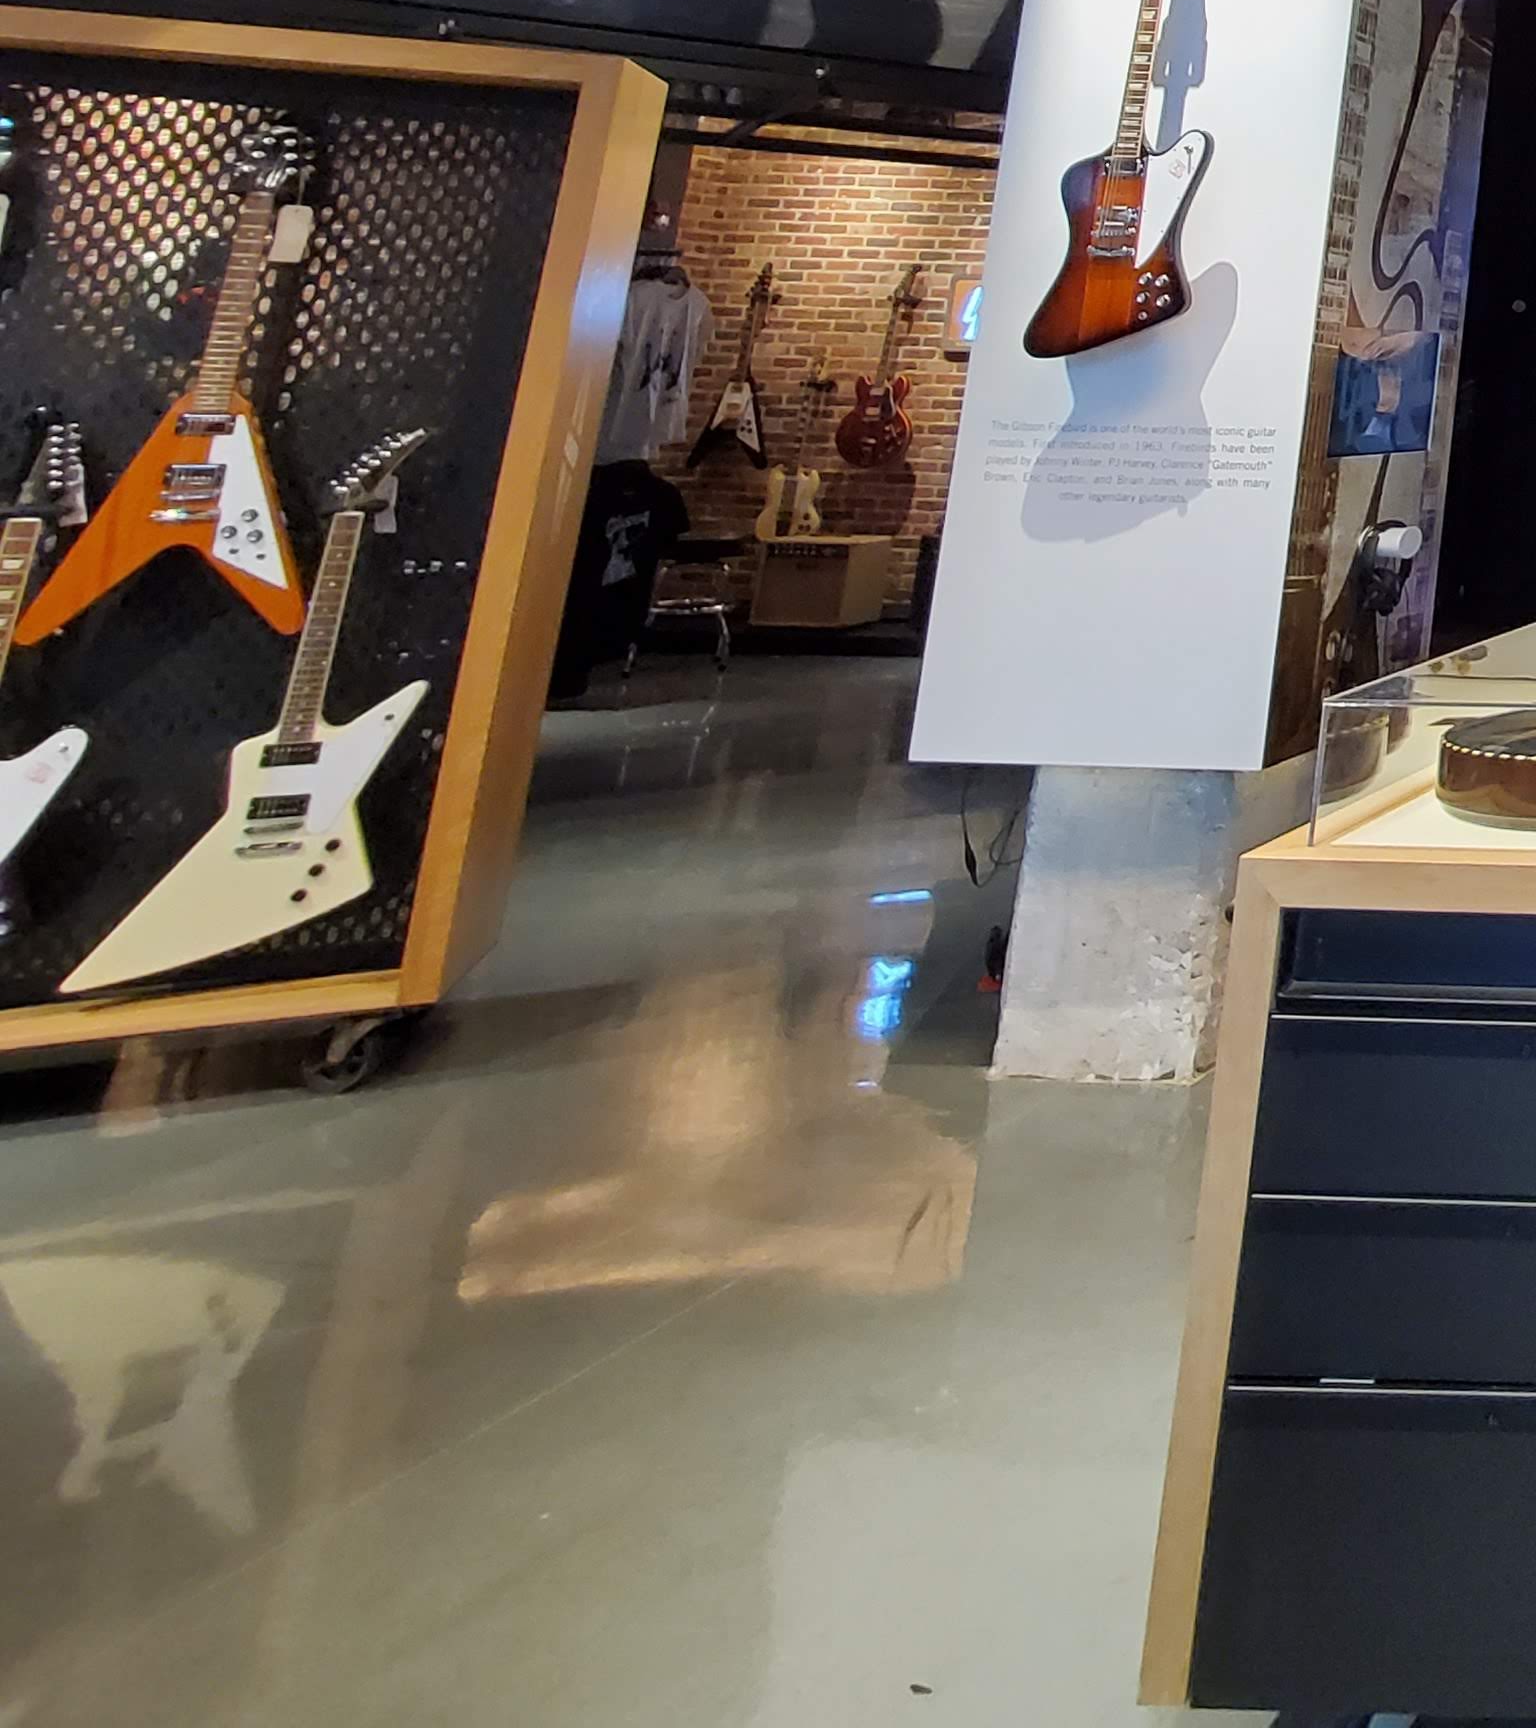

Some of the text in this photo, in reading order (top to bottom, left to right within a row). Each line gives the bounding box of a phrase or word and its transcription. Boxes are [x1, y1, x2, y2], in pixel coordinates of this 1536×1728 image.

[1216, 427, 1245, 437] iconic
[1247, 428, 1276, 439] guitar
[1221, 443, 1245, 453] have
[1249, 444, 1275, 454] been
[1217, 478, 1239, 488] with
[1243, 479, 1271, 490] many
